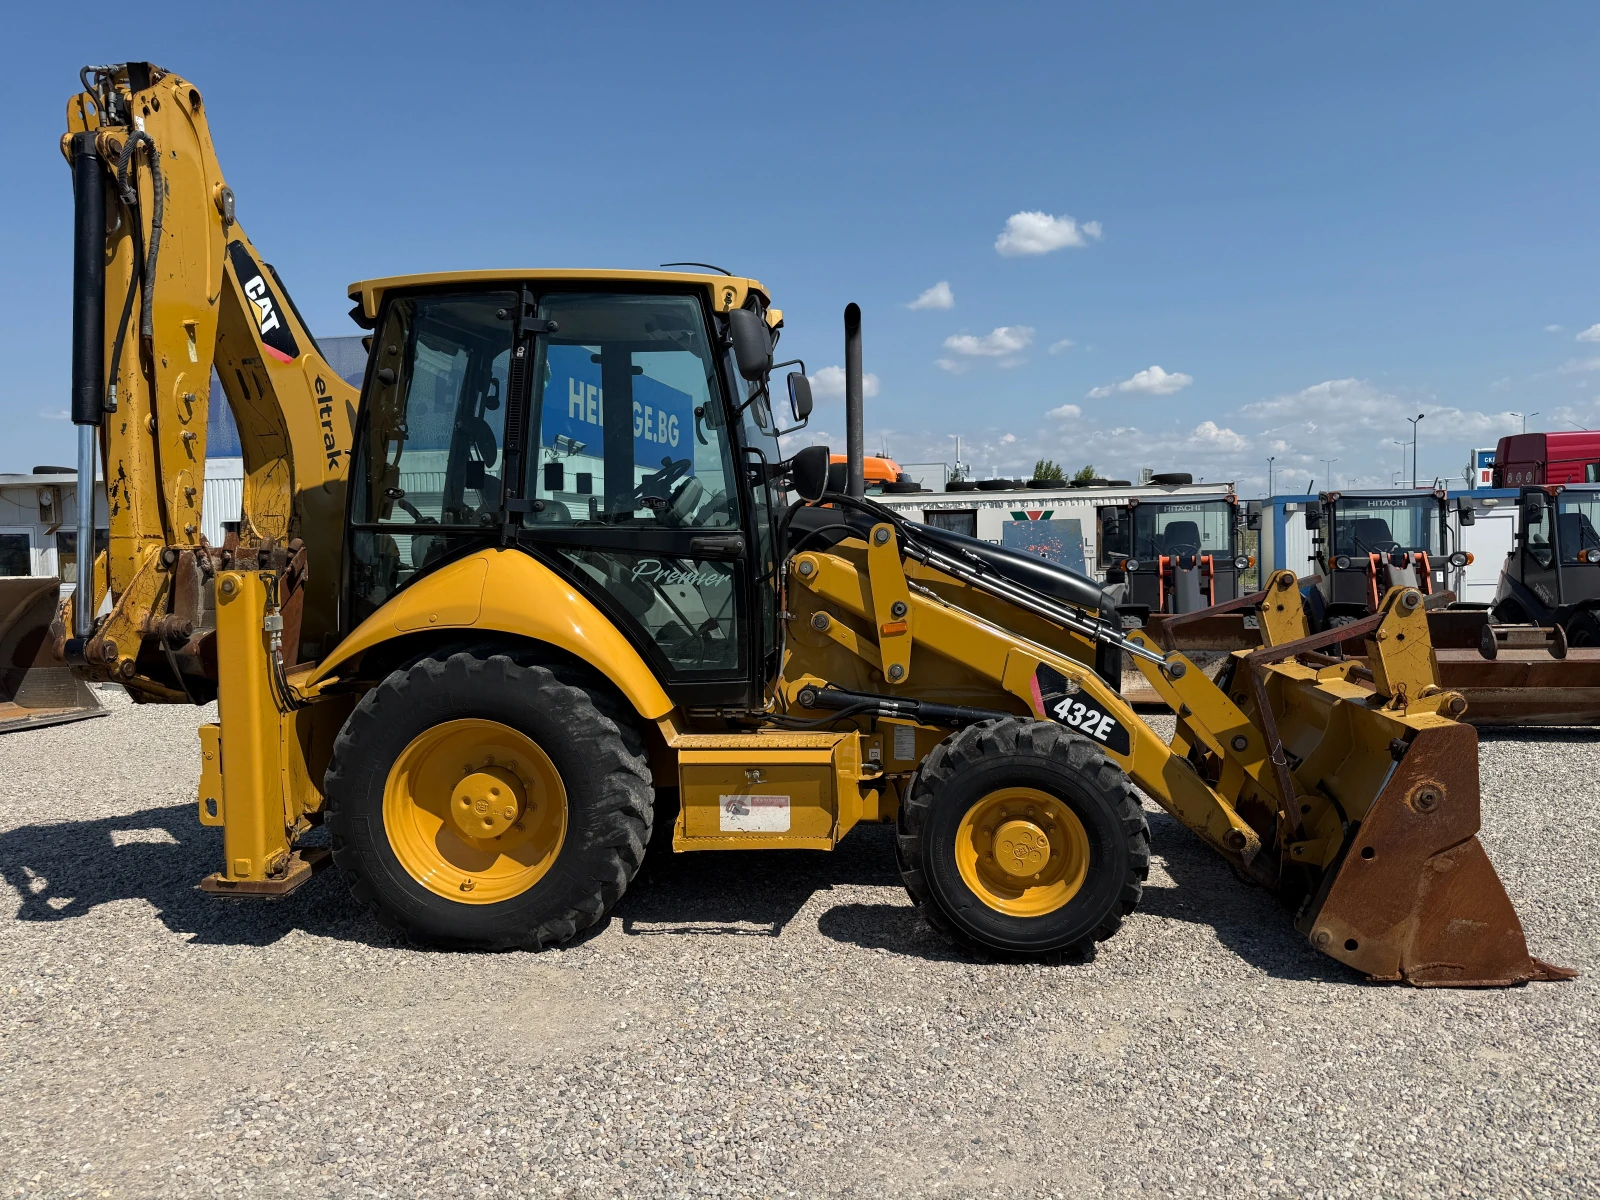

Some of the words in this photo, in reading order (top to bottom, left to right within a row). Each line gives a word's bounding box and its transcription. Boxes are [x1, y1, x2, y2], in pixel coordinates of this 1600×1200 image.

[245, 275, 280, 335] CAT
[314, 374, 342, 471] eltrak
[1163, 504, 1201, 513] HITACHI
[1367, 499, 1407, 507] HITACHI
[630, 558, 731, 587] Premier
[1053, 697, 1117, 741] 432E
